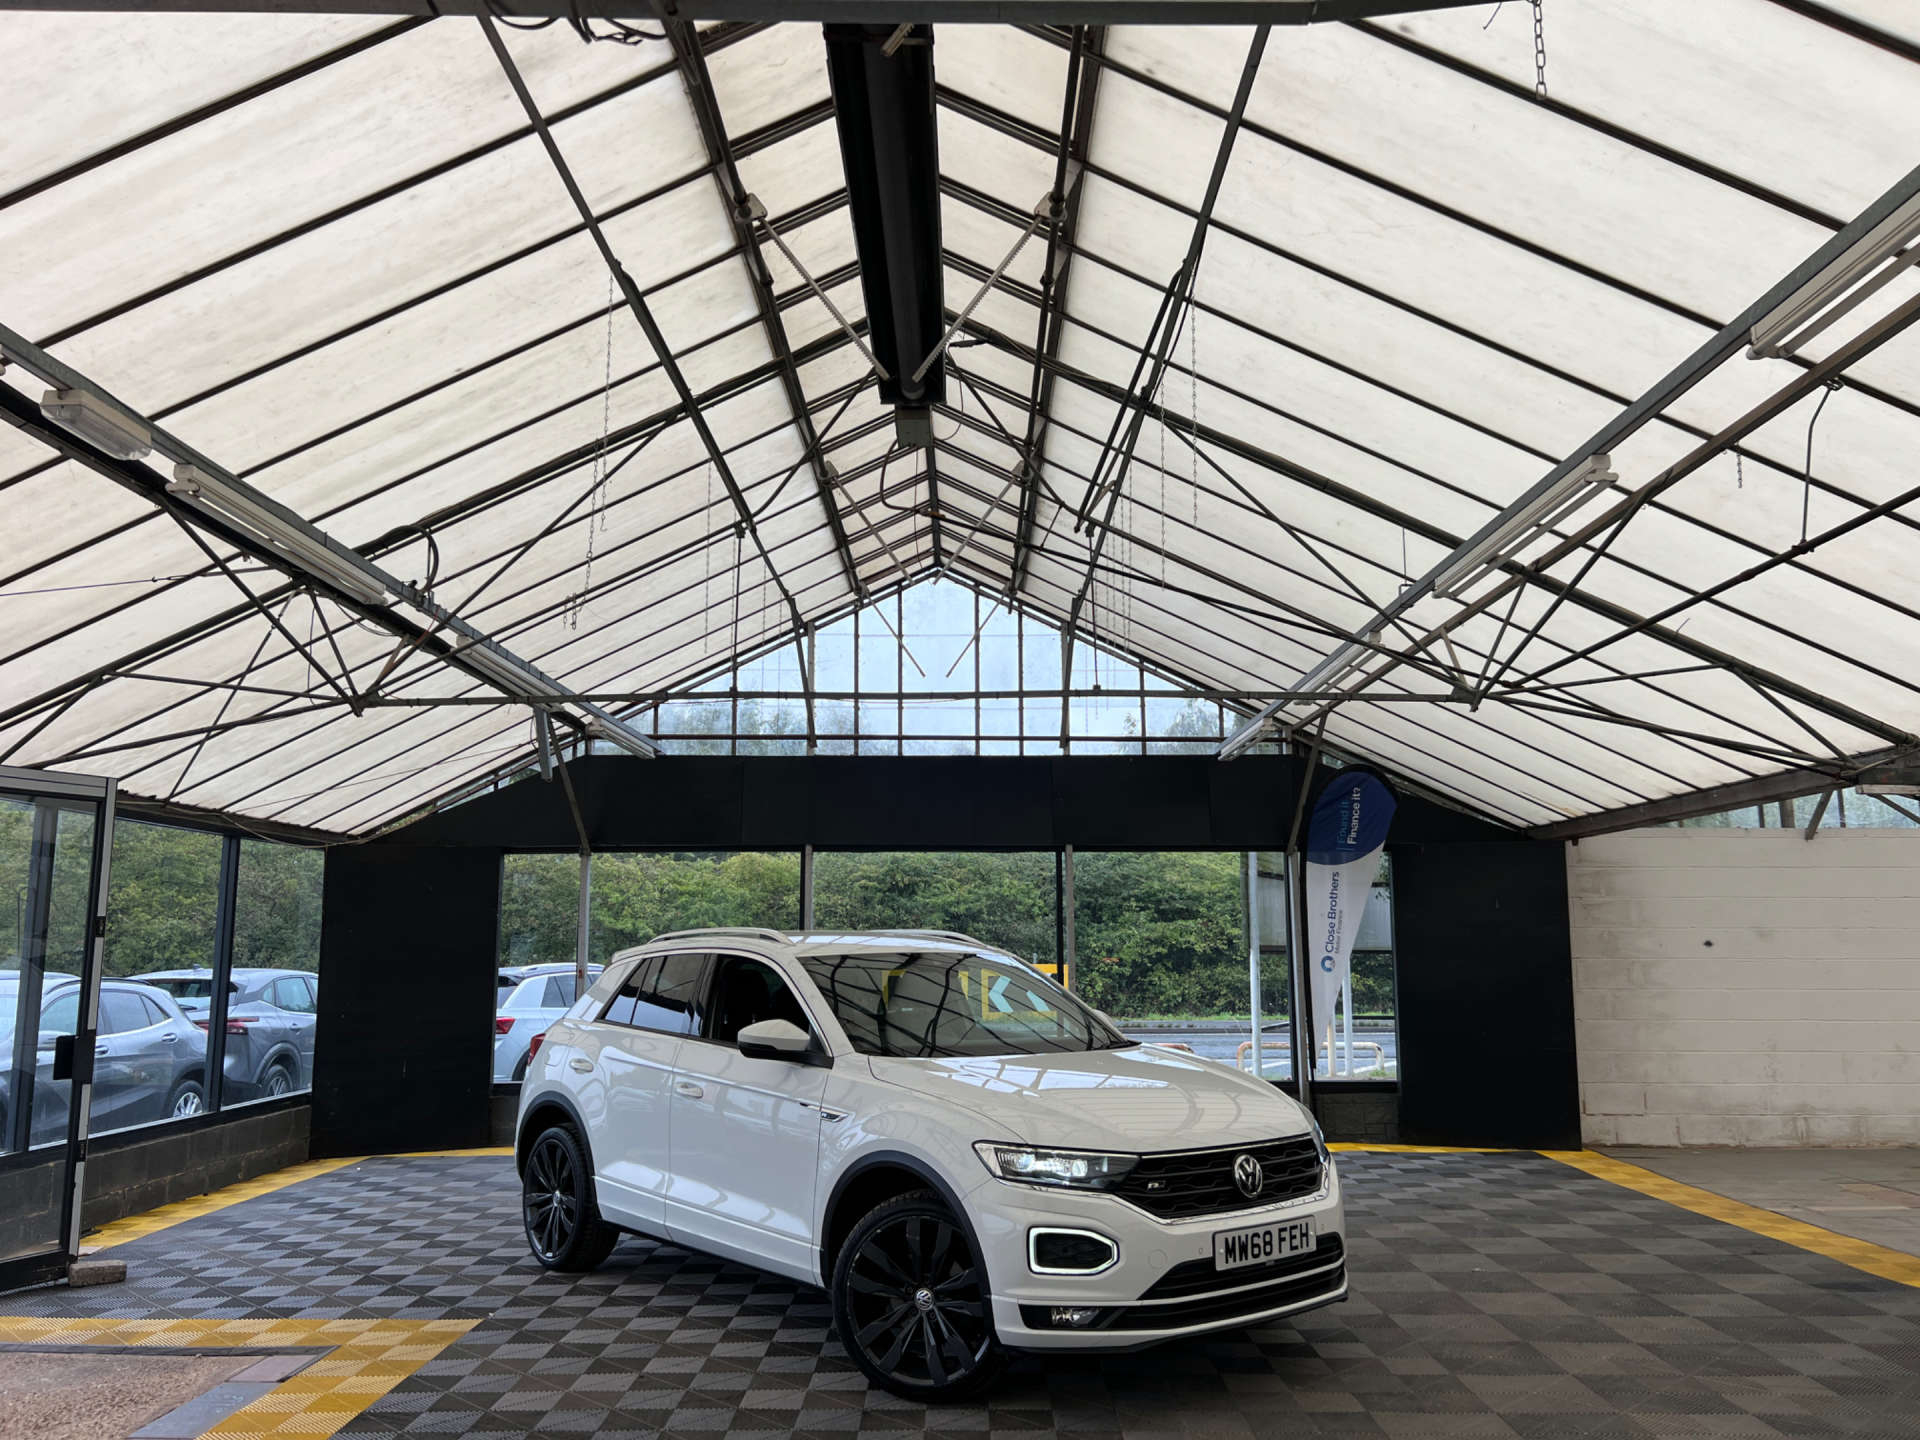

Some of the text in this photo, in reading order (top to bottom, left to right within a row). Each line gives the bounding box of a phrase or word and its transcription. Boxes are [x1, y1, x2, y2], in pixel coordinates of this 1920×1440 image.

[1336, 810, 1347, 844] Found
[1347, 787, 1361, 844] Finance it?
[1324, 871, 1340, 953] Close Brothers
[1224, 1222, 1309, 1264] MW68 FEH
